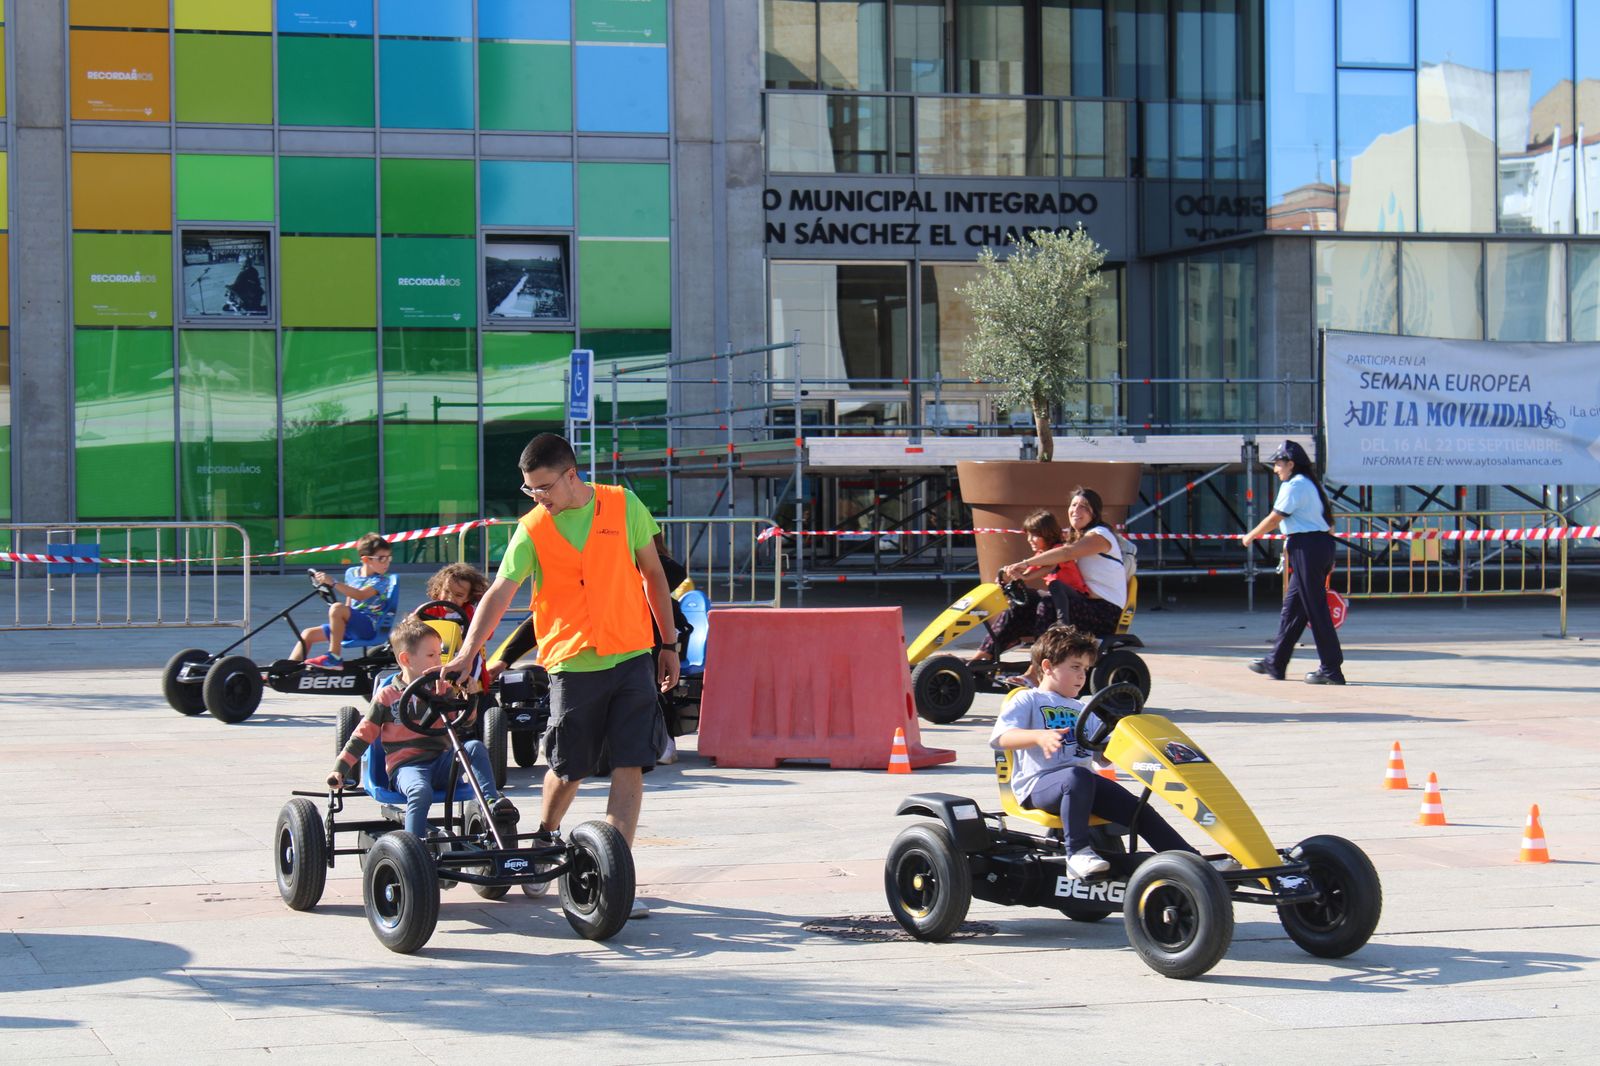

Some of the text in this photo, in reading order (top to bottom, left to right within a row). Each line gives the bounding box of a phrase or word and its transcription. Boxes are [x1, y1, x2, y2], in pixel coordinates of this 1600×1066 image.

[789, 190, 937, 212] MUNICIPAL
[945, 191, 1098, 215] INTEGRADO
[794, 217, 921, 245] SÁNCHEZ
[930, 225, 957, 246] EL
[1346, 354, 1426, 366] PARTICIPA EN LA
[1360, 371, 1531, 392] SEMANA EUROPEA
[1361, 400, 1542, 428] DE LA MOVILIDAD
[1361, 438, 1563, 453] DEL 16 AL 22 DE SEPTIEMBRE
[1362, 455, 1563, 469] INFÓRMATE EN: www.aytosalamanca.es
[298, 676, 356, 689] BERG
[1132, 762, 1162, 771] BERG
[504, 860, 529, 868] BERG
[1055, 875, 1126, 903] BERG
